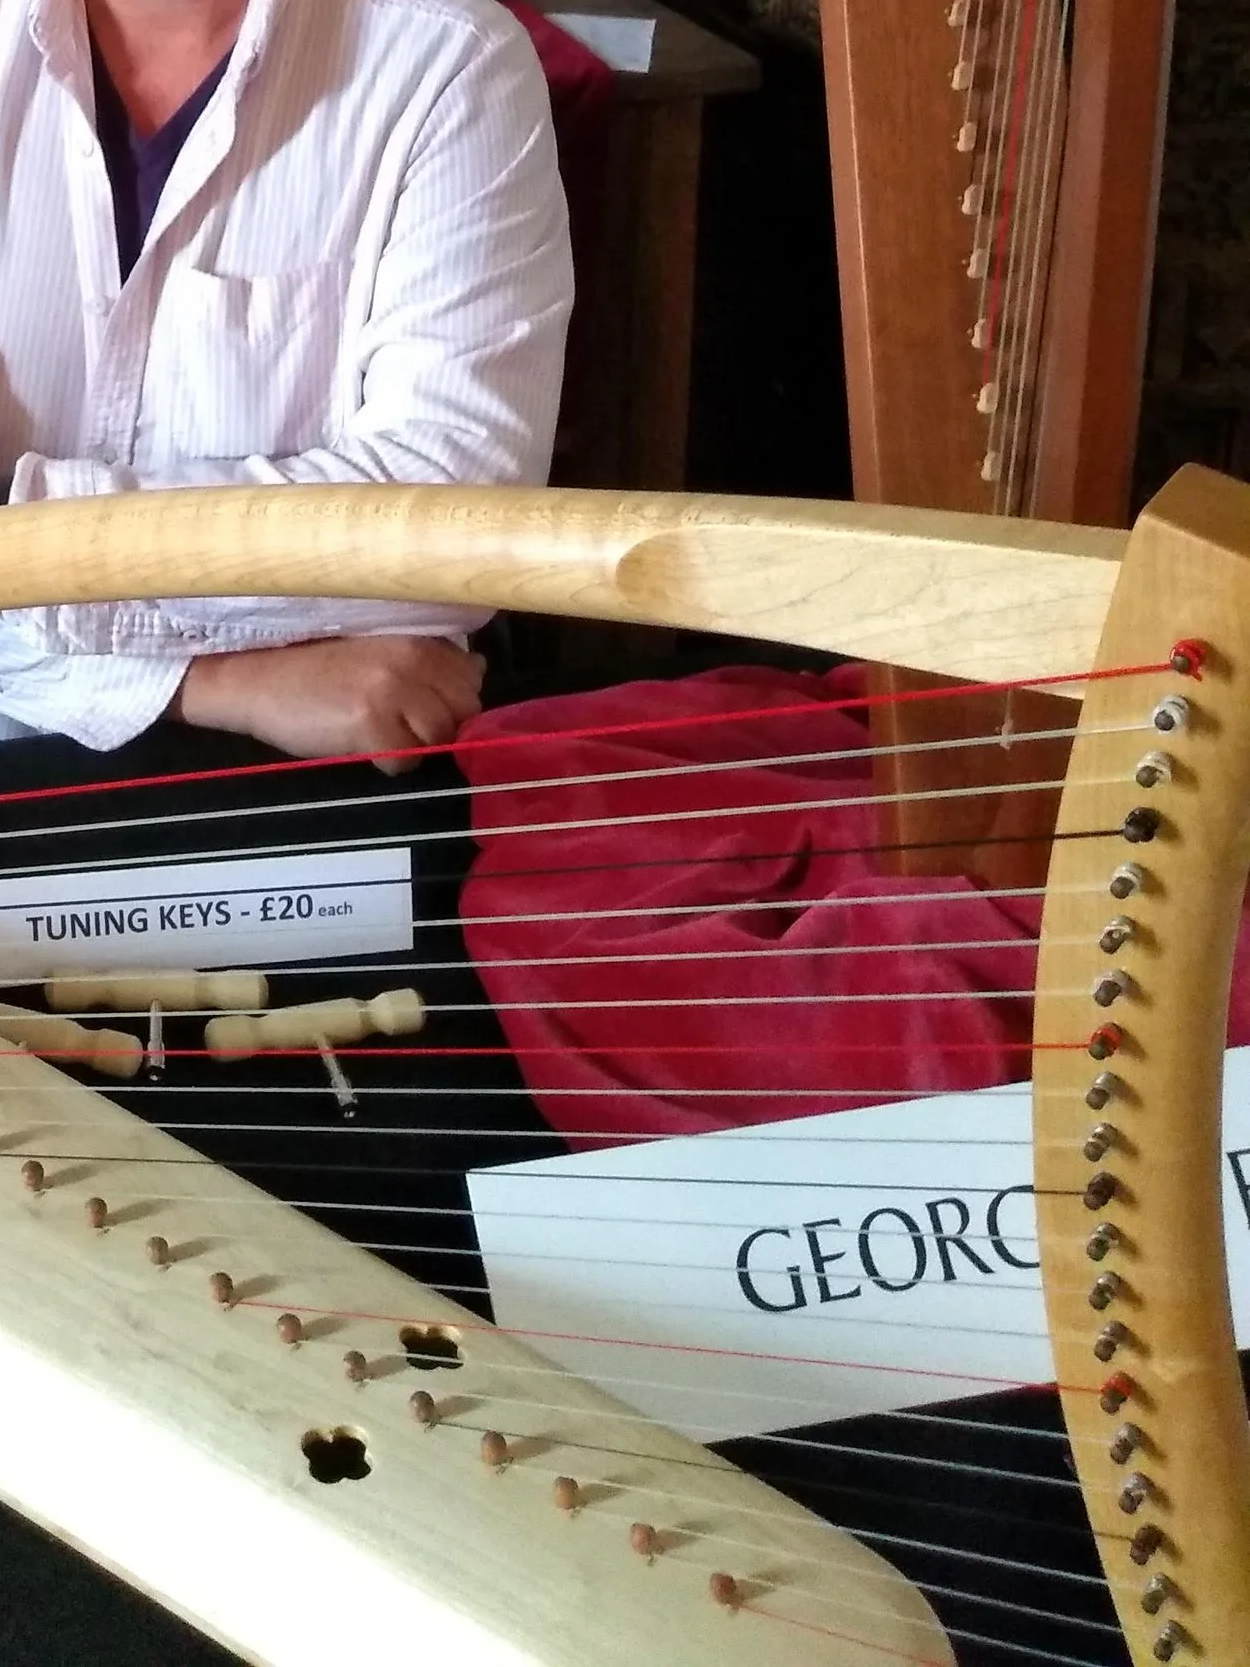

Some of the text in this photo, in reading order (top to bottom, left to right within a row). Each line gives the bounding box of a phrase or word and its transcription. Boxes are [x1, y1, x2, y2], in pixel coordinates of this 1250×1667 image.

[25, 907, 149, 942] TUNING
[159, 899, 232, 931] KEYS
[259, 893, 314, 923] £20
[318, 900, 353, 918] each
[735, 1183, 1041, 1315] GEORG
